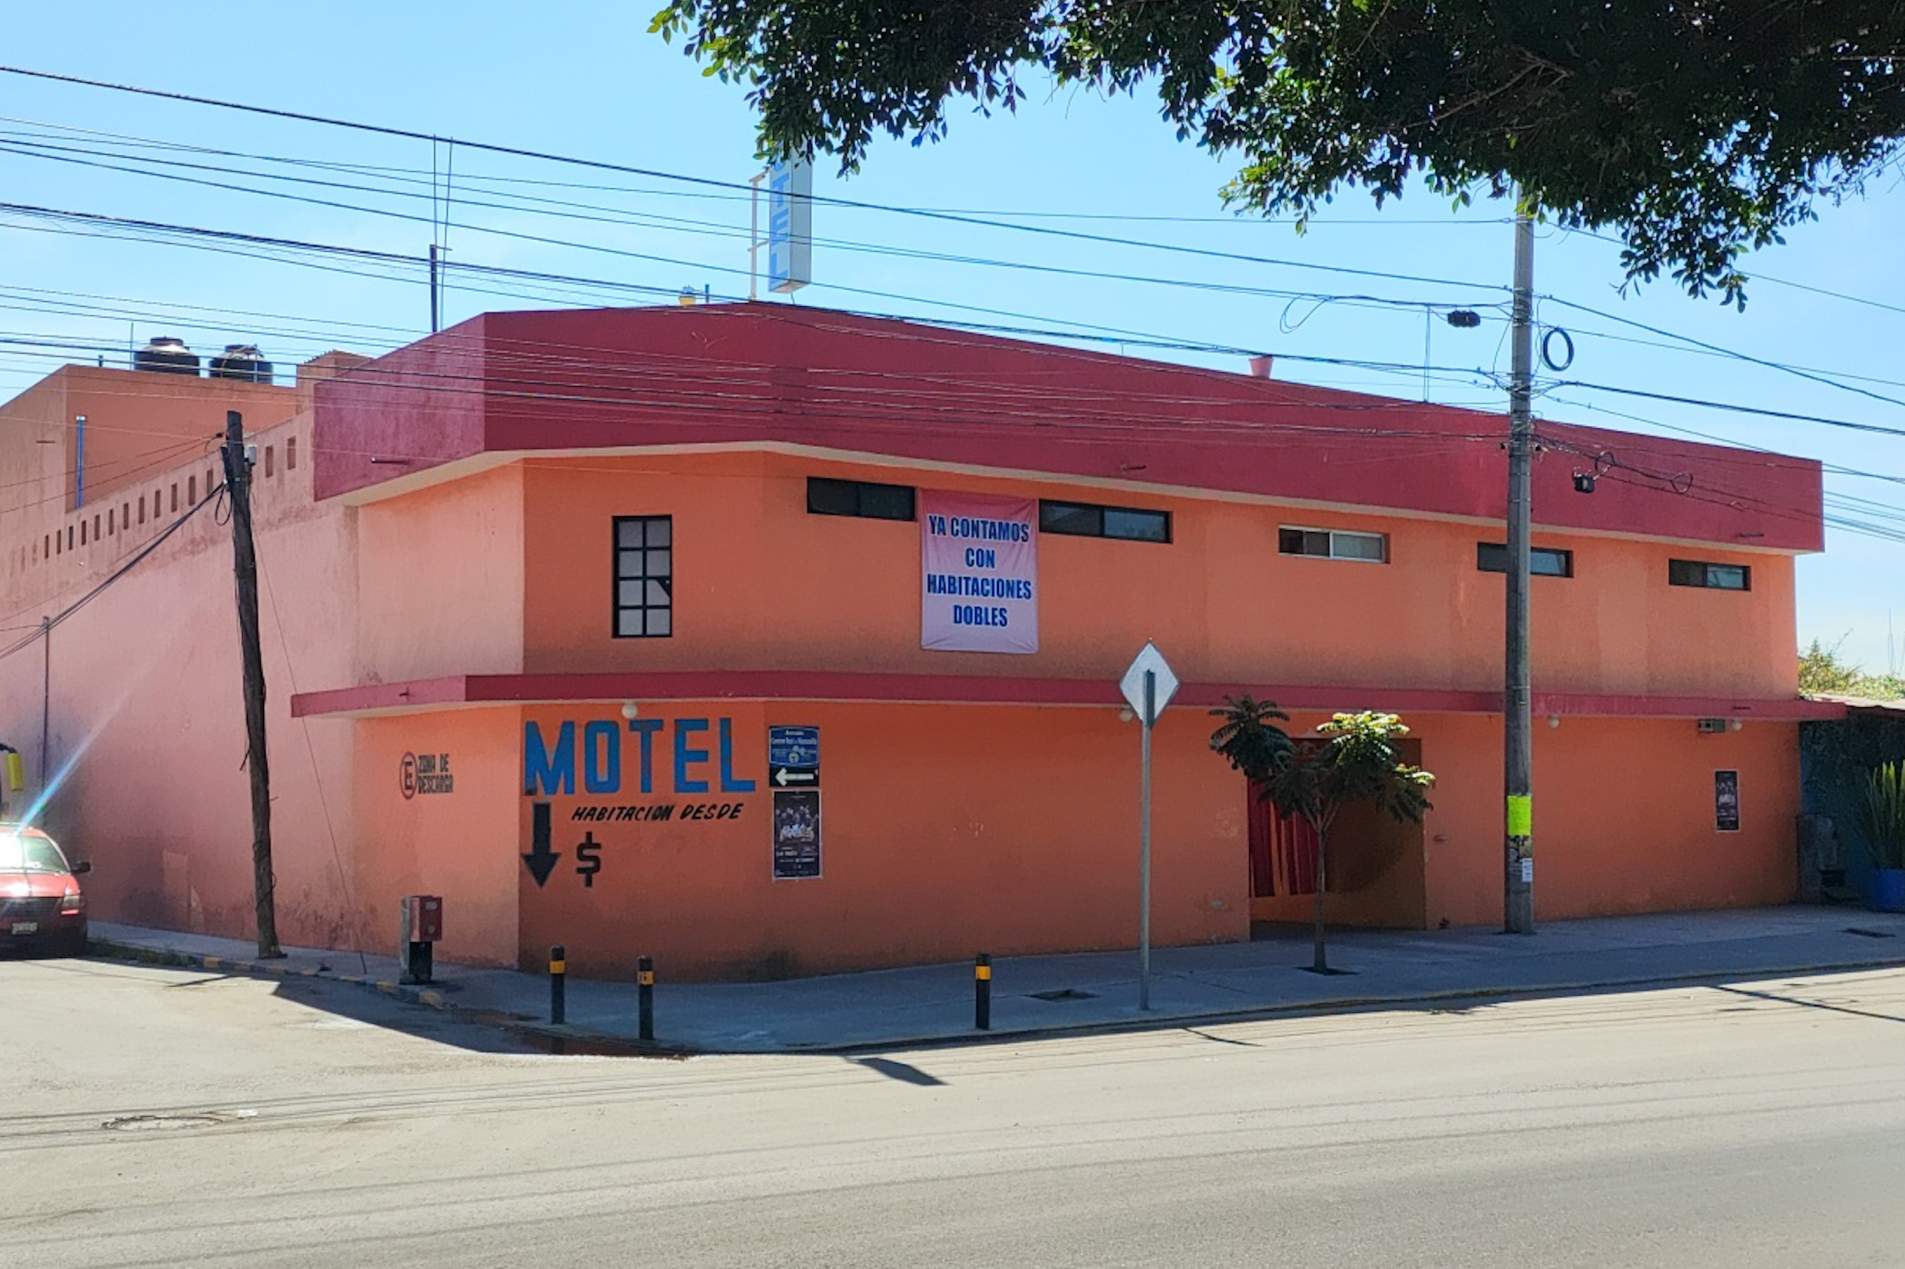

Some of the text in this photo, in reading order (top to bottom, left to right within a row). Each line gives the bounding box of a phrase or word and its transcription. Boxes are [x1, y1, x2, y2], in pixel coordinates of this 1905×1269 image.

[929, 514, 1030, 543] YA CONTAMOS
[965, 547, 995, 569] CON
[927, 573, 1032, 600] HABITACIONES
[953, 604, 1008, 627] DOBLES
[440, 753, 449, 773] DE
[524, 717, 756, 796] MOTEL
[571, 803, 745, 822] HABITACION DESDE
[576, 831, 602, 888] $
